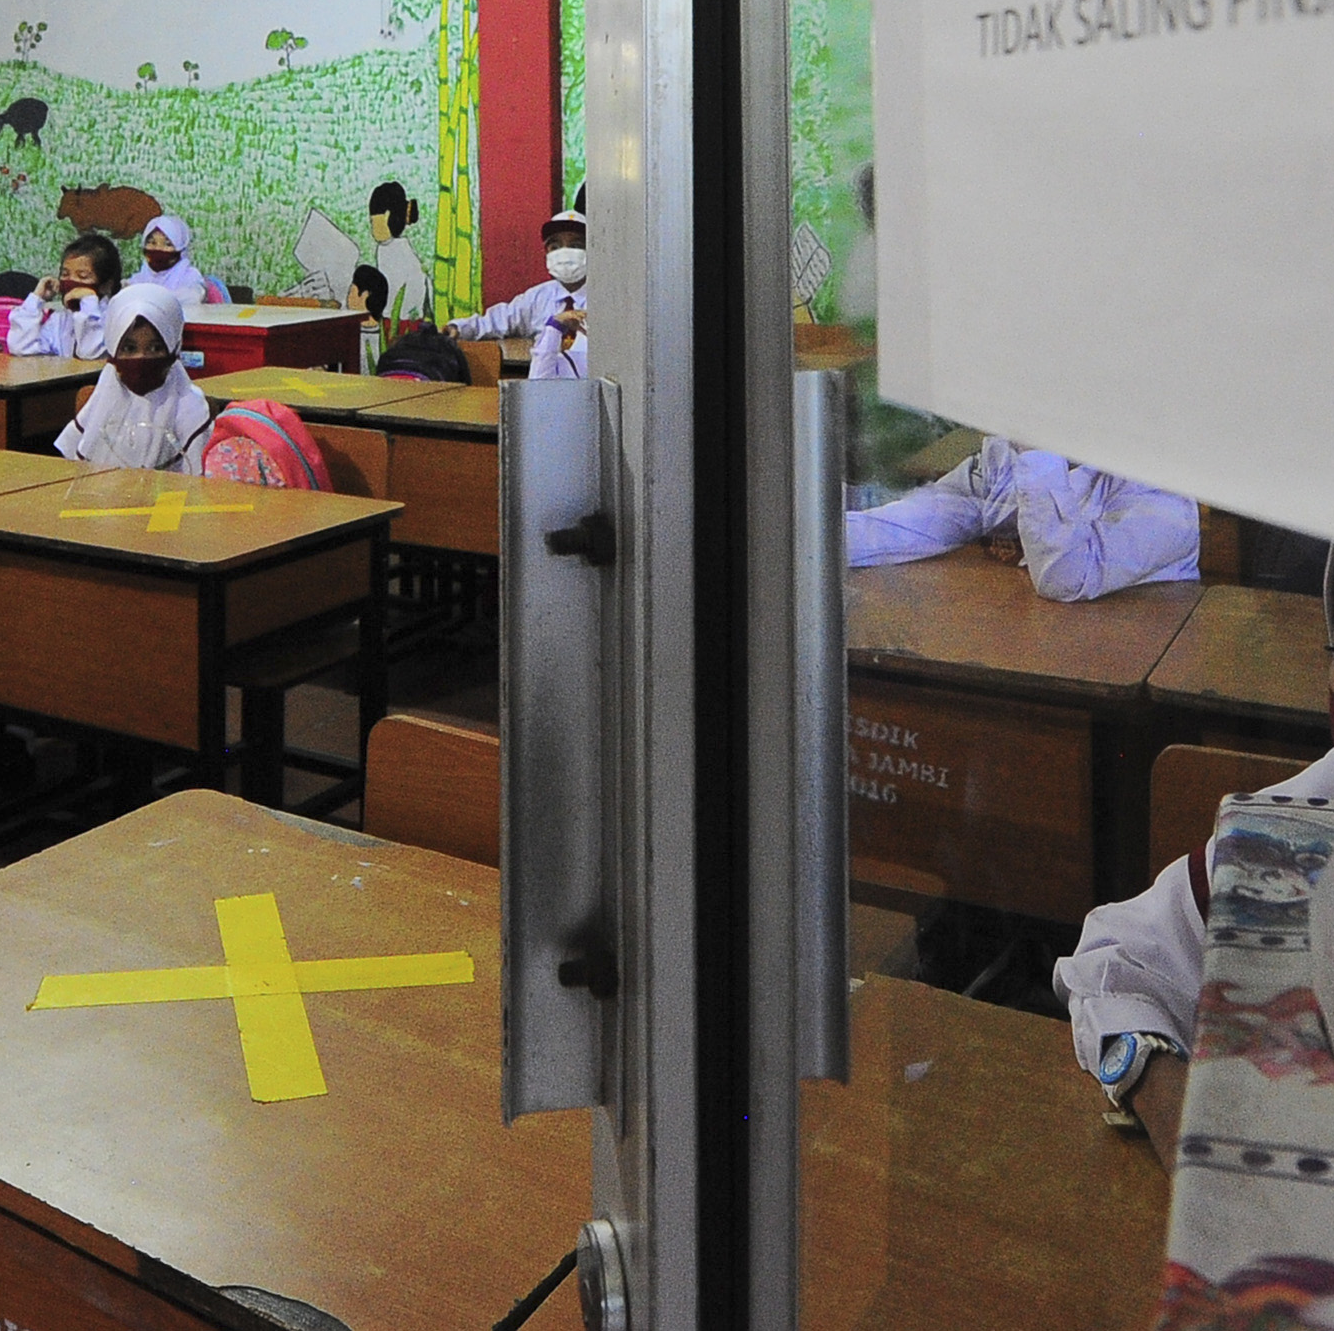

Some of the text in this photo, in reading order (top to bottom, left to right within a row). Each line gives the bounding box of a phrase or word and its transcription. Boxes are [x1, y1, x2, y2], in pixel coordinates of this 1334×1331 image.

[975, 2, 1065, 58] TIDAK
[868, 752, 950, 789] JAMBI
[848, 775, 898, 804] 016
